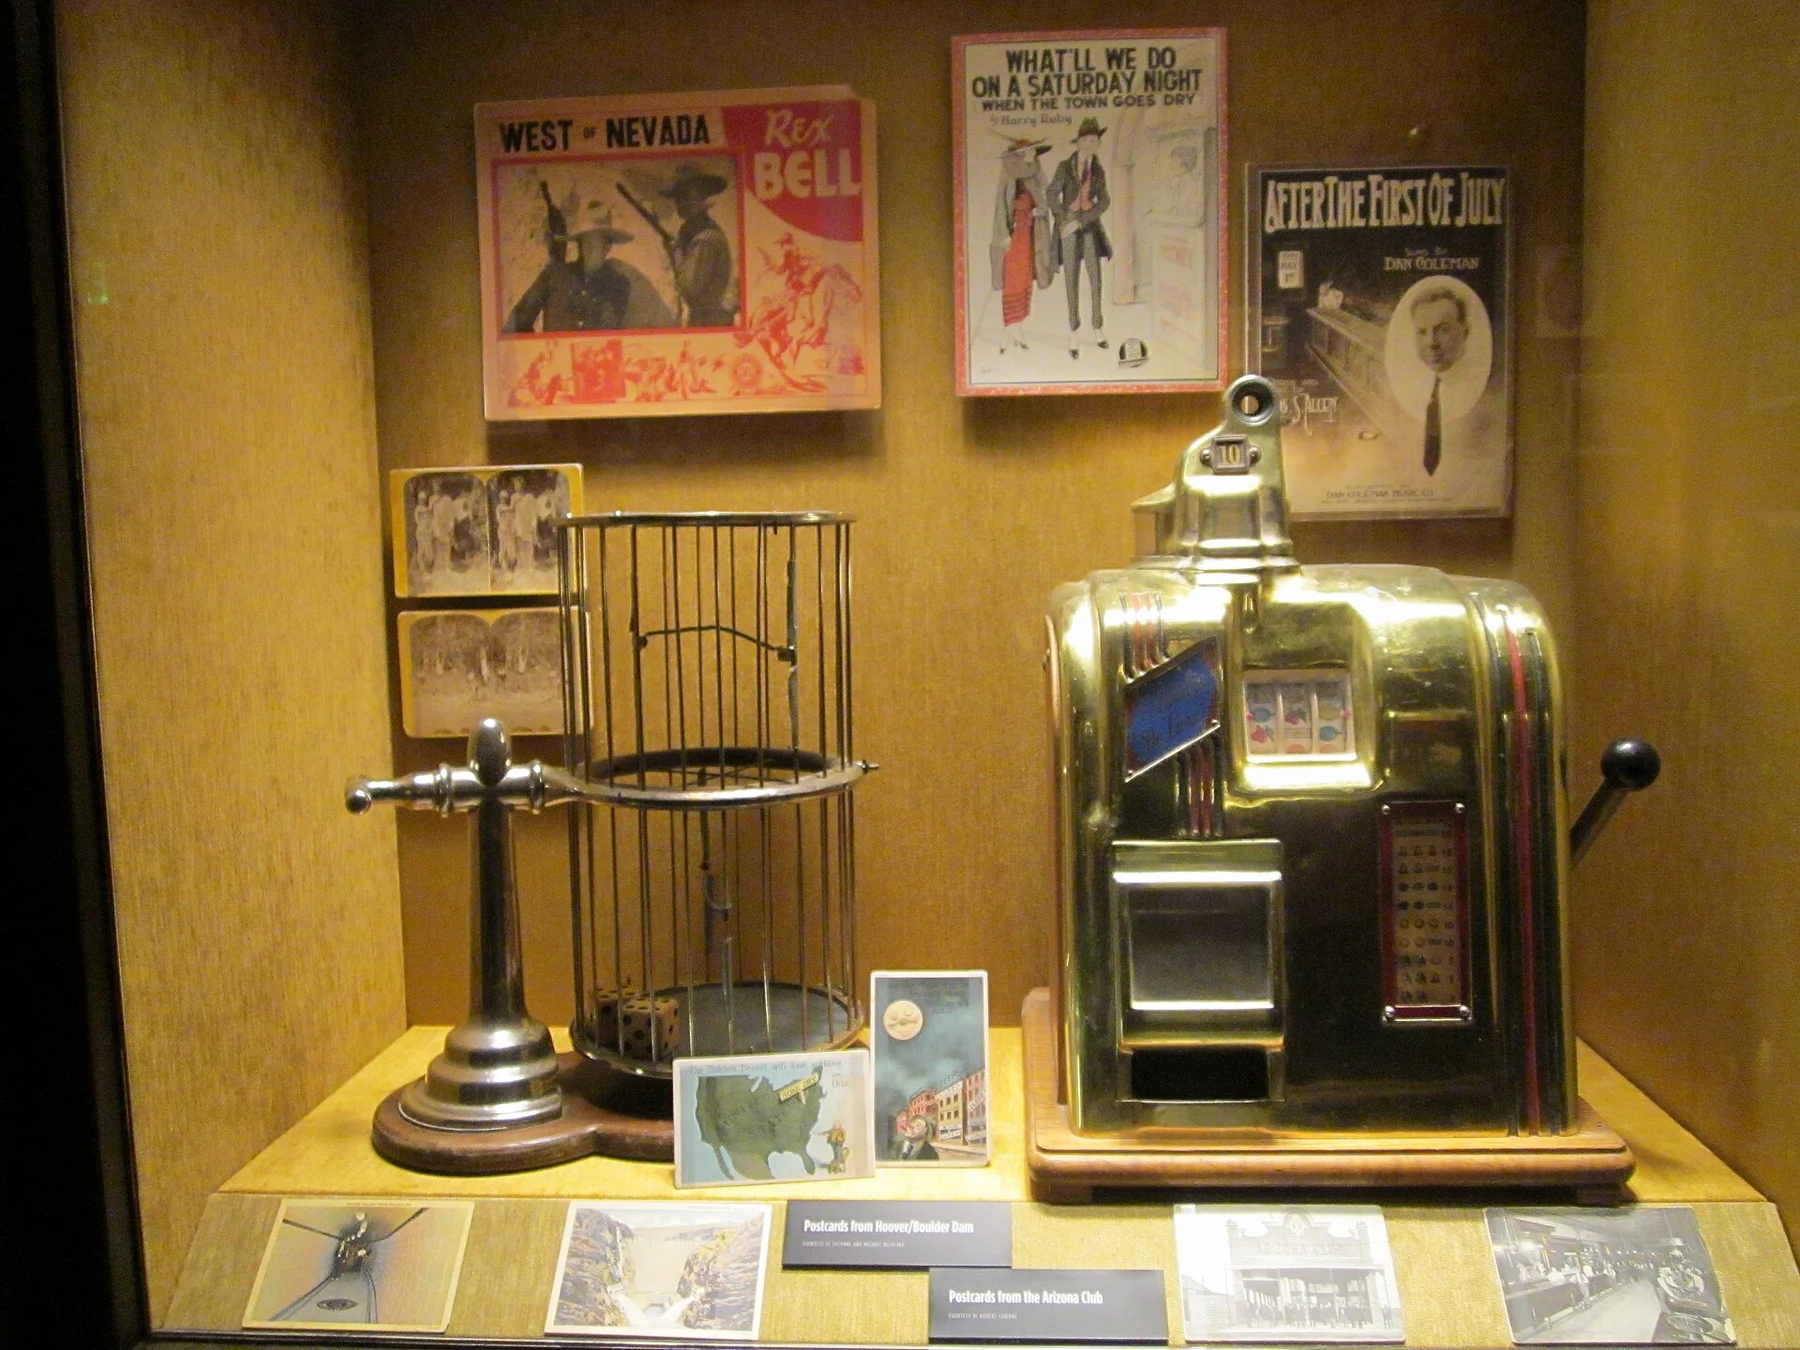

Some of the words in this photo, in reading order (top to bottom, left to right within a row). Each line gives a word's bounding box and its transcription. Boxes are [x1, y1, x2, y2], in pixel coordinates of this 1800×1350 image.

[1006, 48, 1095, 73] WHAT'LL
[1106, 47, 1136, 70] WE
[1148, 46, 1176, 69] DO
[972, 76, 1000, 97] ON
[1007, 75, 1021, 97] A
[1027, 71, 1136, 96] SATURDAY
[1144, 69, 1202, 92] NIGHT
[982, 99, 1024, 111] WHEN
[1031, 98, 1058, 110] THE
[1065, 97, 1108, 109] TOWN
[1113, 94, 1155, 107] GOES
[1164, 94, 1195, 106] DRY
[500, 119, 573, 152] WEST
[583, 127, 596, 140] OF
[606, 114, 710, 149] NEVADA
[754, 148, 861, 199] BELL
[1368, 174, 1426, 226] FIRST
[1427, 172, 1454, 226] OF
[1455, 172, 1505, 227] JULY
[803, 1219, 849, 1233] Postcards
[850, 1219, 874, 1233] from
[875, 1219, 950, 1234] Hoover/Boulder
[951, 1220, 975, 1233] Dam
[949, 1290, 996, 1304] Postcards
[998, 1290, 1022, 1304] from
[1023, 1291, 1040, 1304] the
[1042, 1290, 1080, 1304] Arizona
[1081, 1290, 1104, 1304] Club
